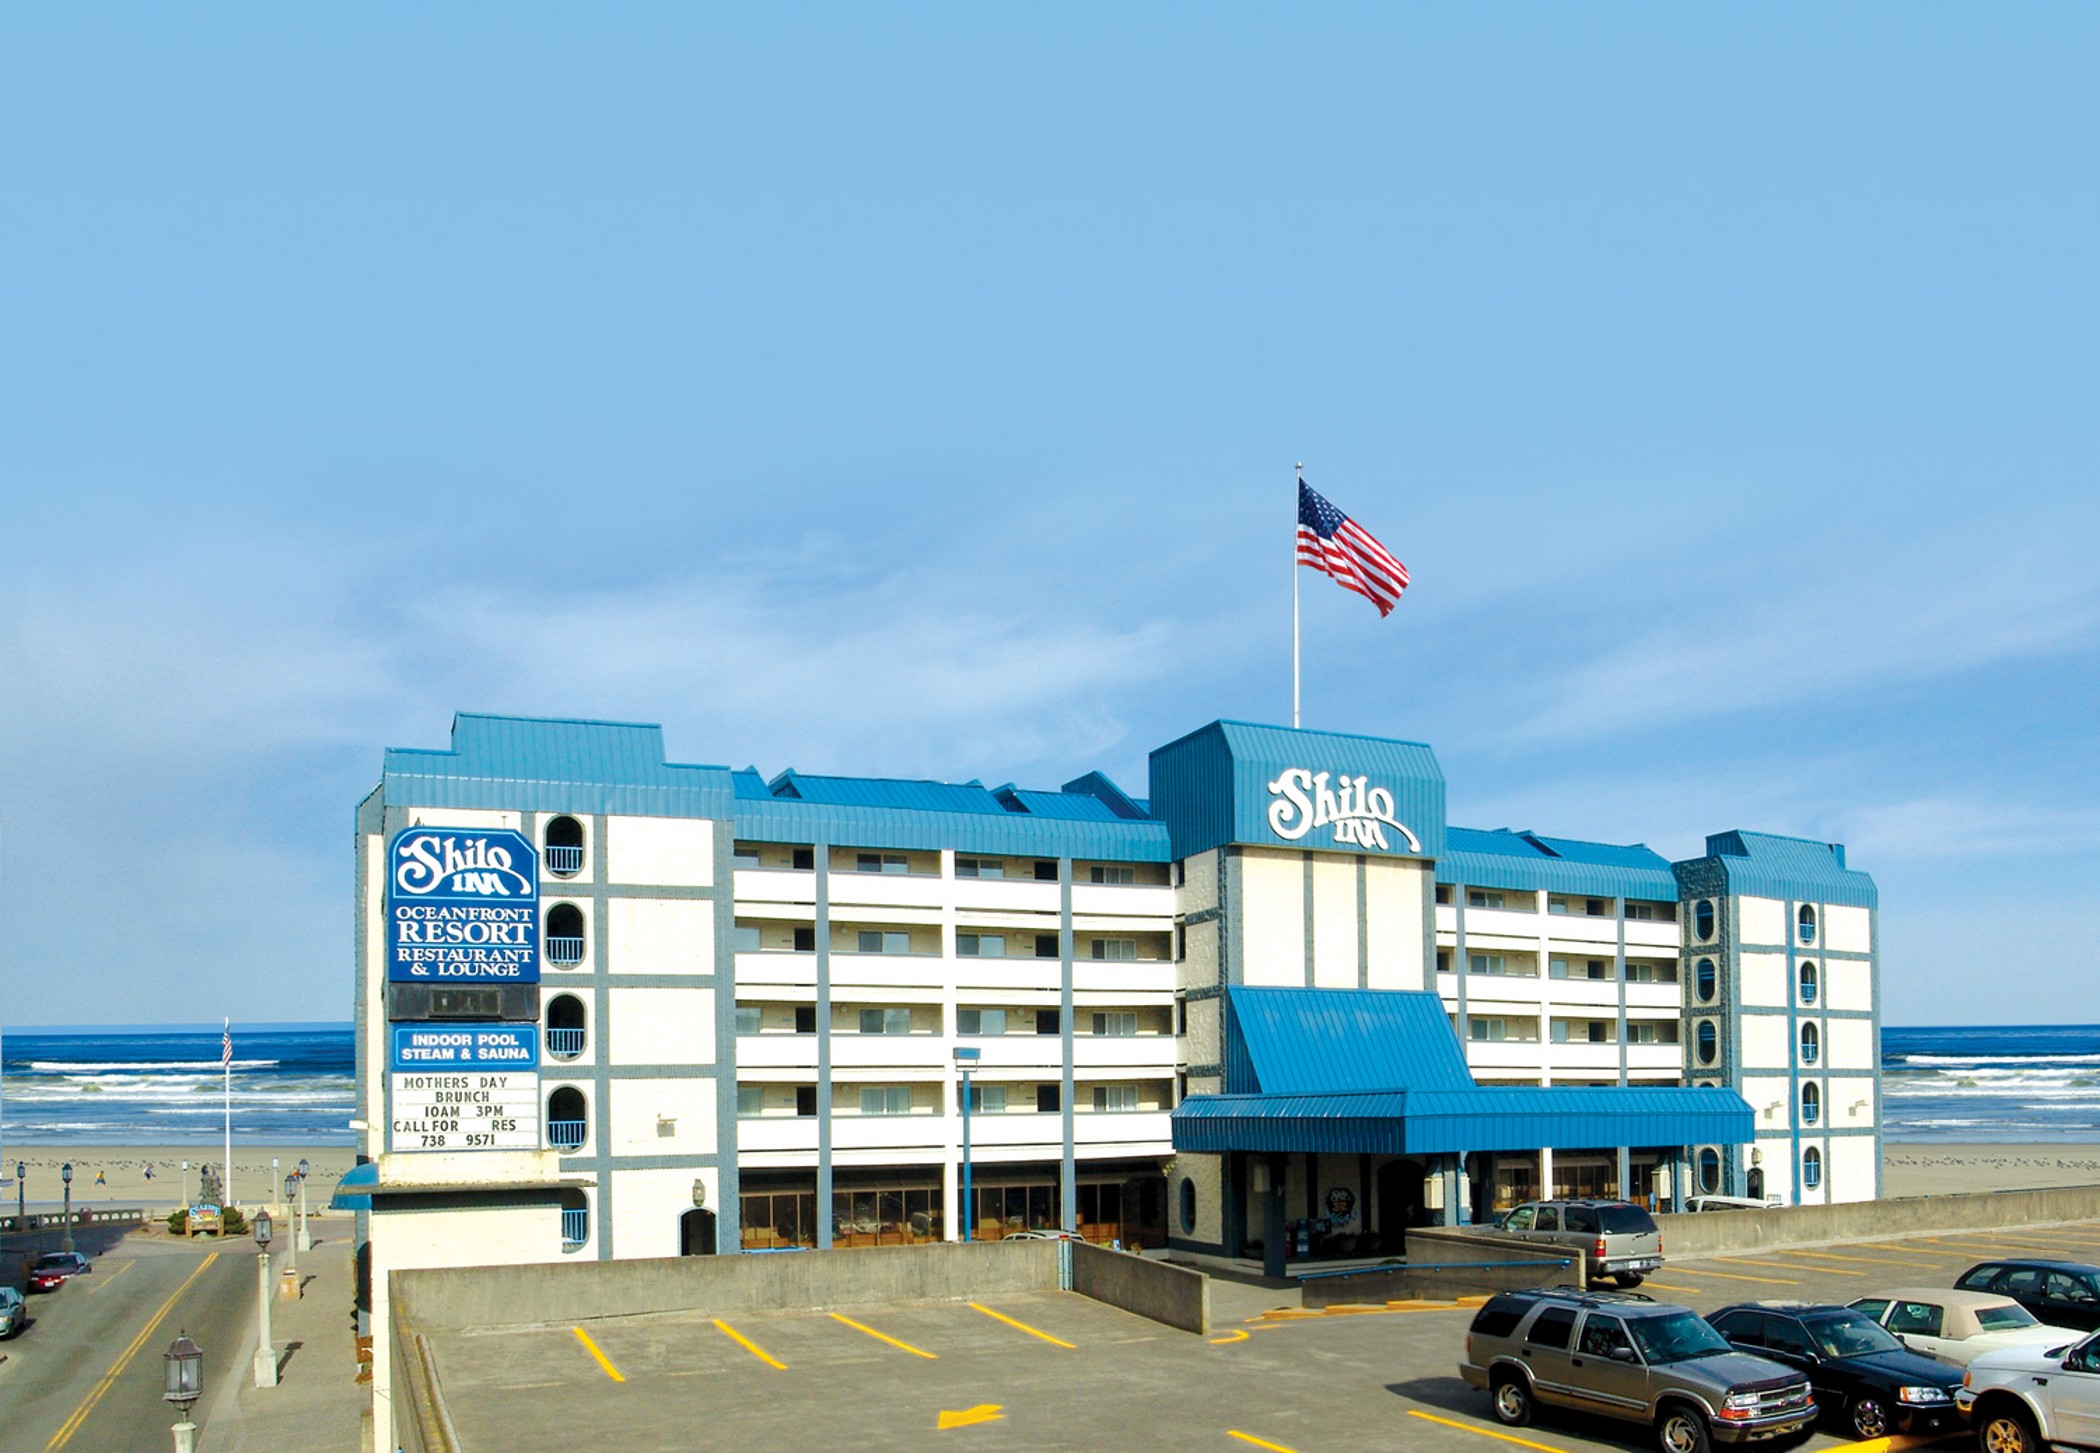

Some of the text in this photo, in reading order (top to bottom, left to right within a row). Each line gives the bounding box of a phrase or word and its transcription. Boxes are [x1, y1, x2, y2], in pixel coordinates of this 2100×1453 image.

[1268, 768, 1421, 853] Shilo
[397, 836, 532, 895] Shilo
[396, 906, 533, 921] OCEANFRONT
[396, 921, 533, 944] RESORT
[397, 948, 533, 962] RESTAURANT
[410, 962, 520, 976] & LOUNGE
[412, 1034, 519, 1046] INDOOR POOL
[402, 1048, 530, 1060] STEAM & SAUNA
[404, 1076, 508, 1088] MOTHERS DAY
[436, 1091, 490, 1103] BRUNCH
[425, 1105, 503, 1117] 10AM 3PM
[393, 1119, 516, 1132] CALL FOR RES
[421, 1134, 495, 1147] 738 9571
